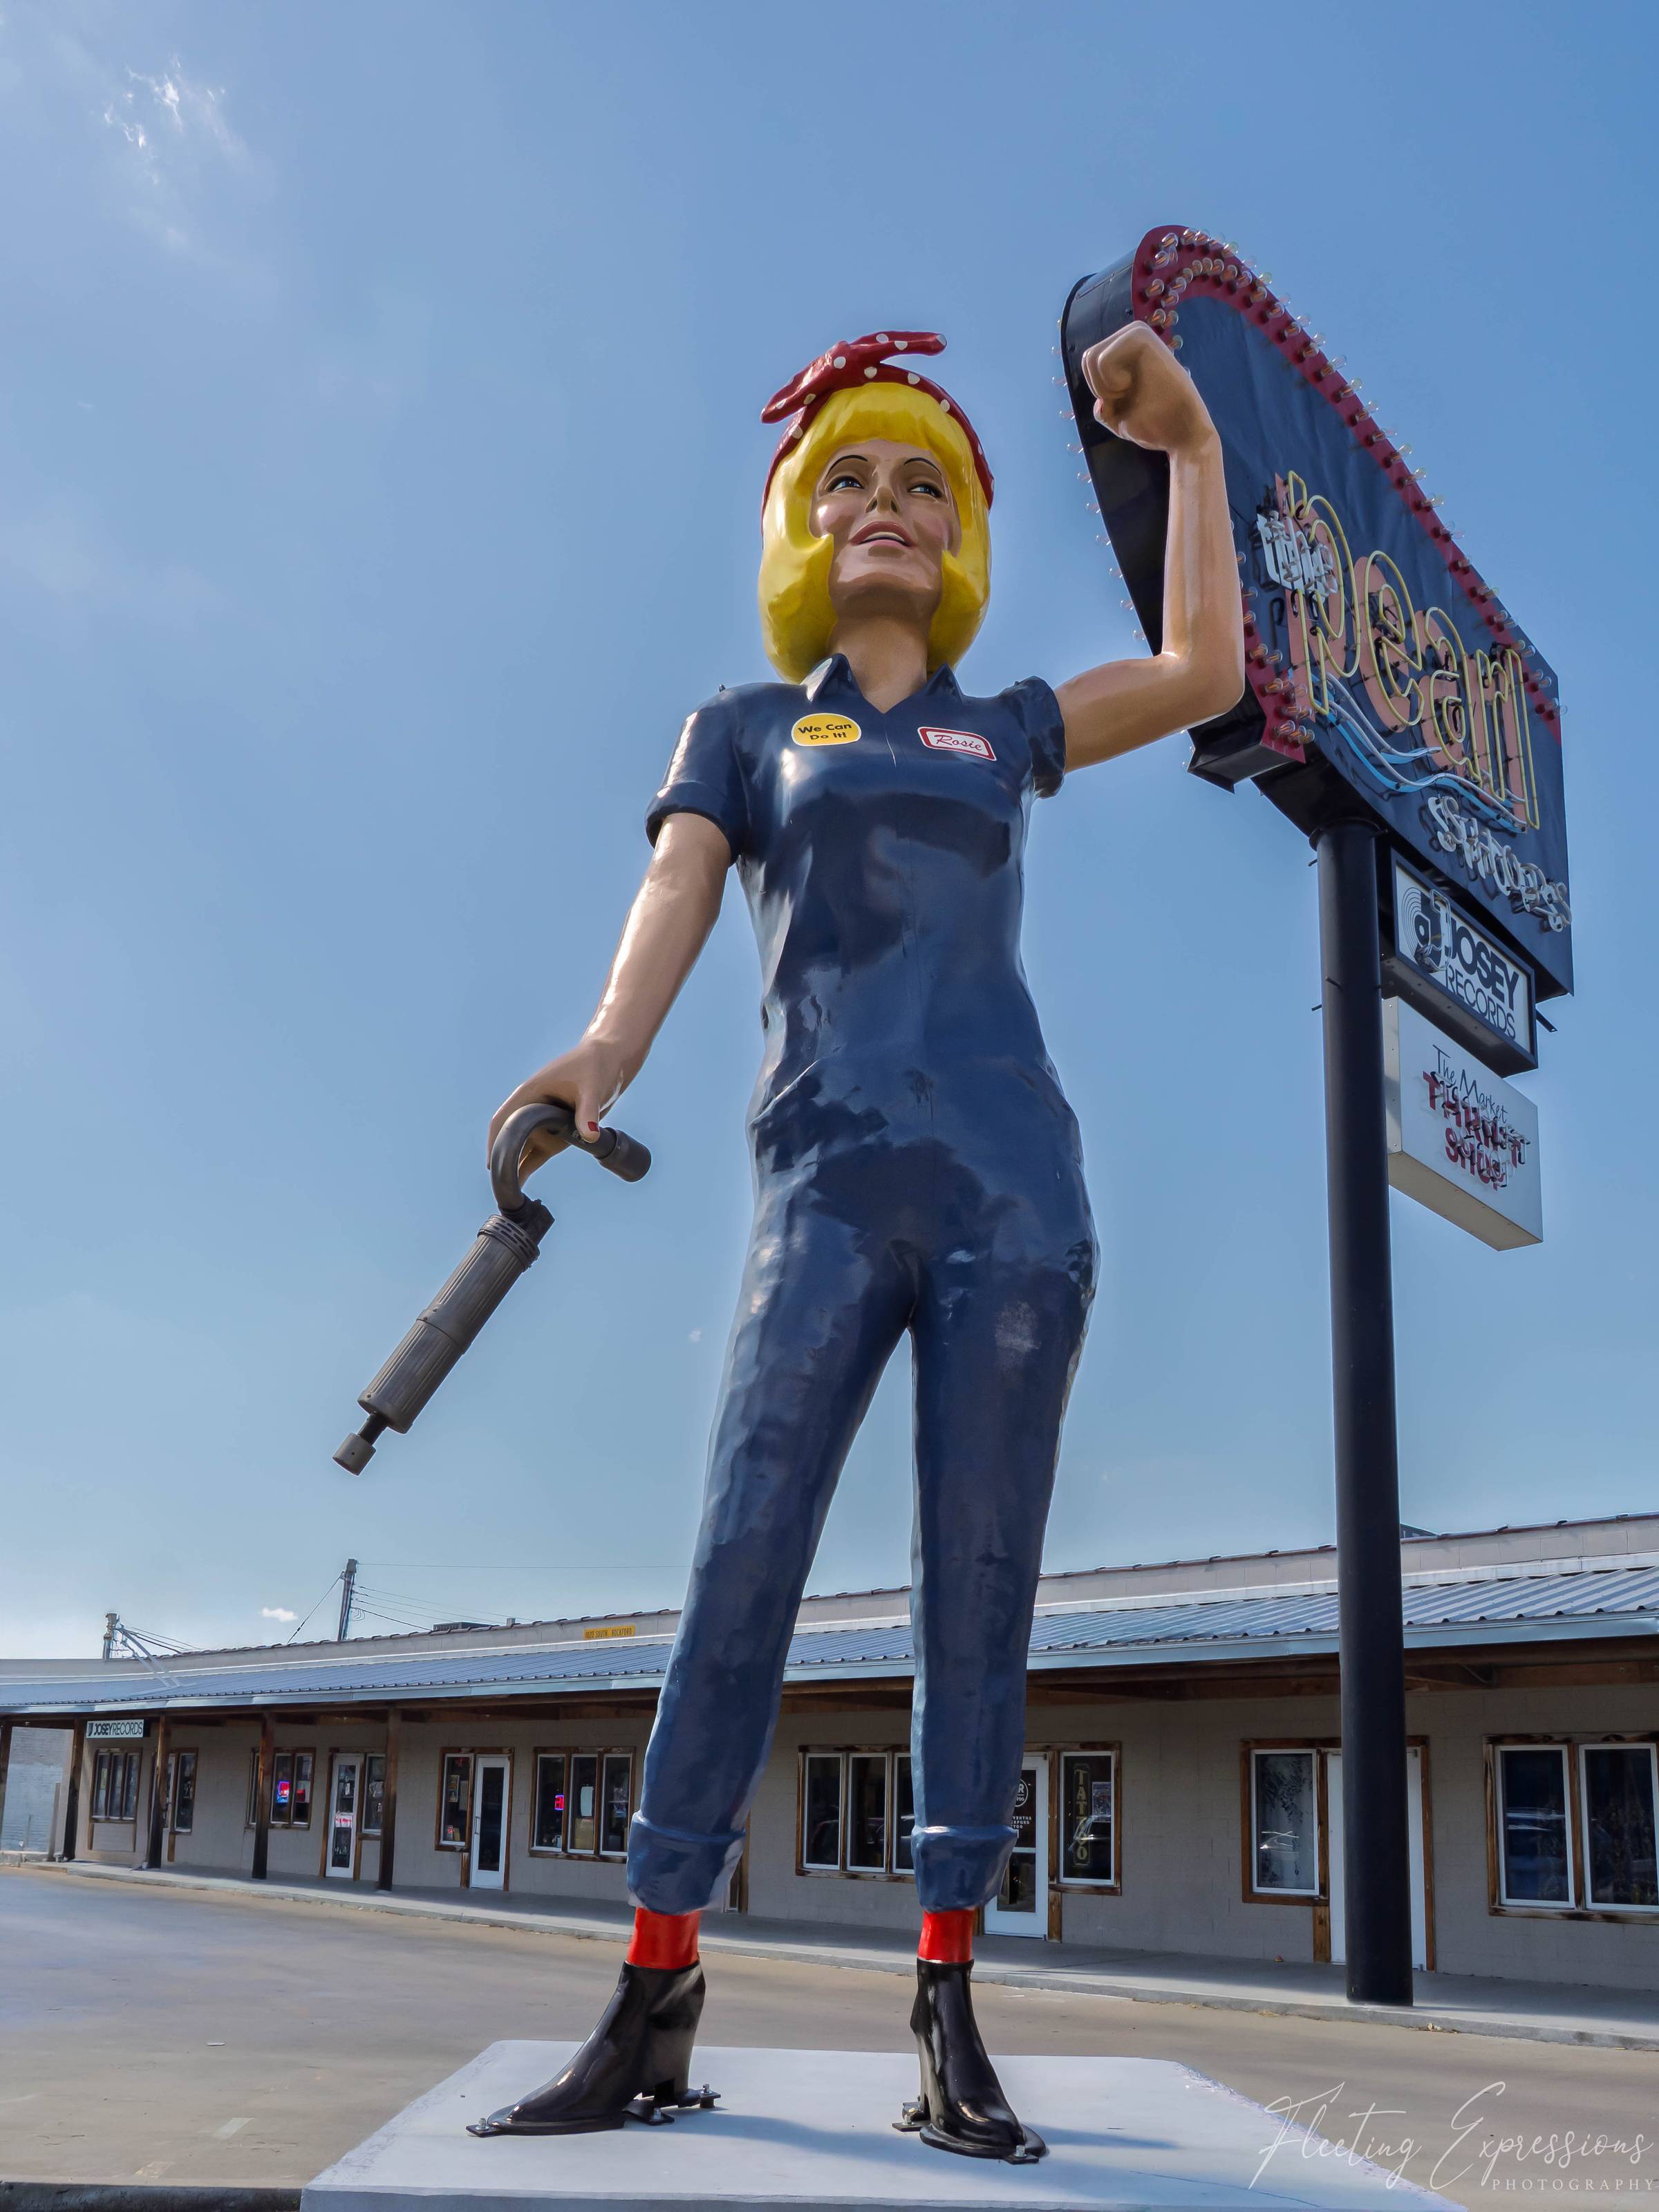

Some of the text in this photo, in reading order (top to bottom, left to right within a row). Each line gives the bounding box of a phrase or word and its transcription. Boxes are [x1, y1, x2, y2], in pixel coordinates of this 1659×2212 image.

[1275, 469, 1541, 831] Pearl
[798, 726, 822, 734] We
[933, 734, 982, 751] Rosie
[1444, 917, 1519, 1011] JOSEY
[1445, 966, 1516, 1041] RECORDS
[1432, 1044, 1508, 1124] The Market
[1074, 1770, 1088, 1860] TATTOO
